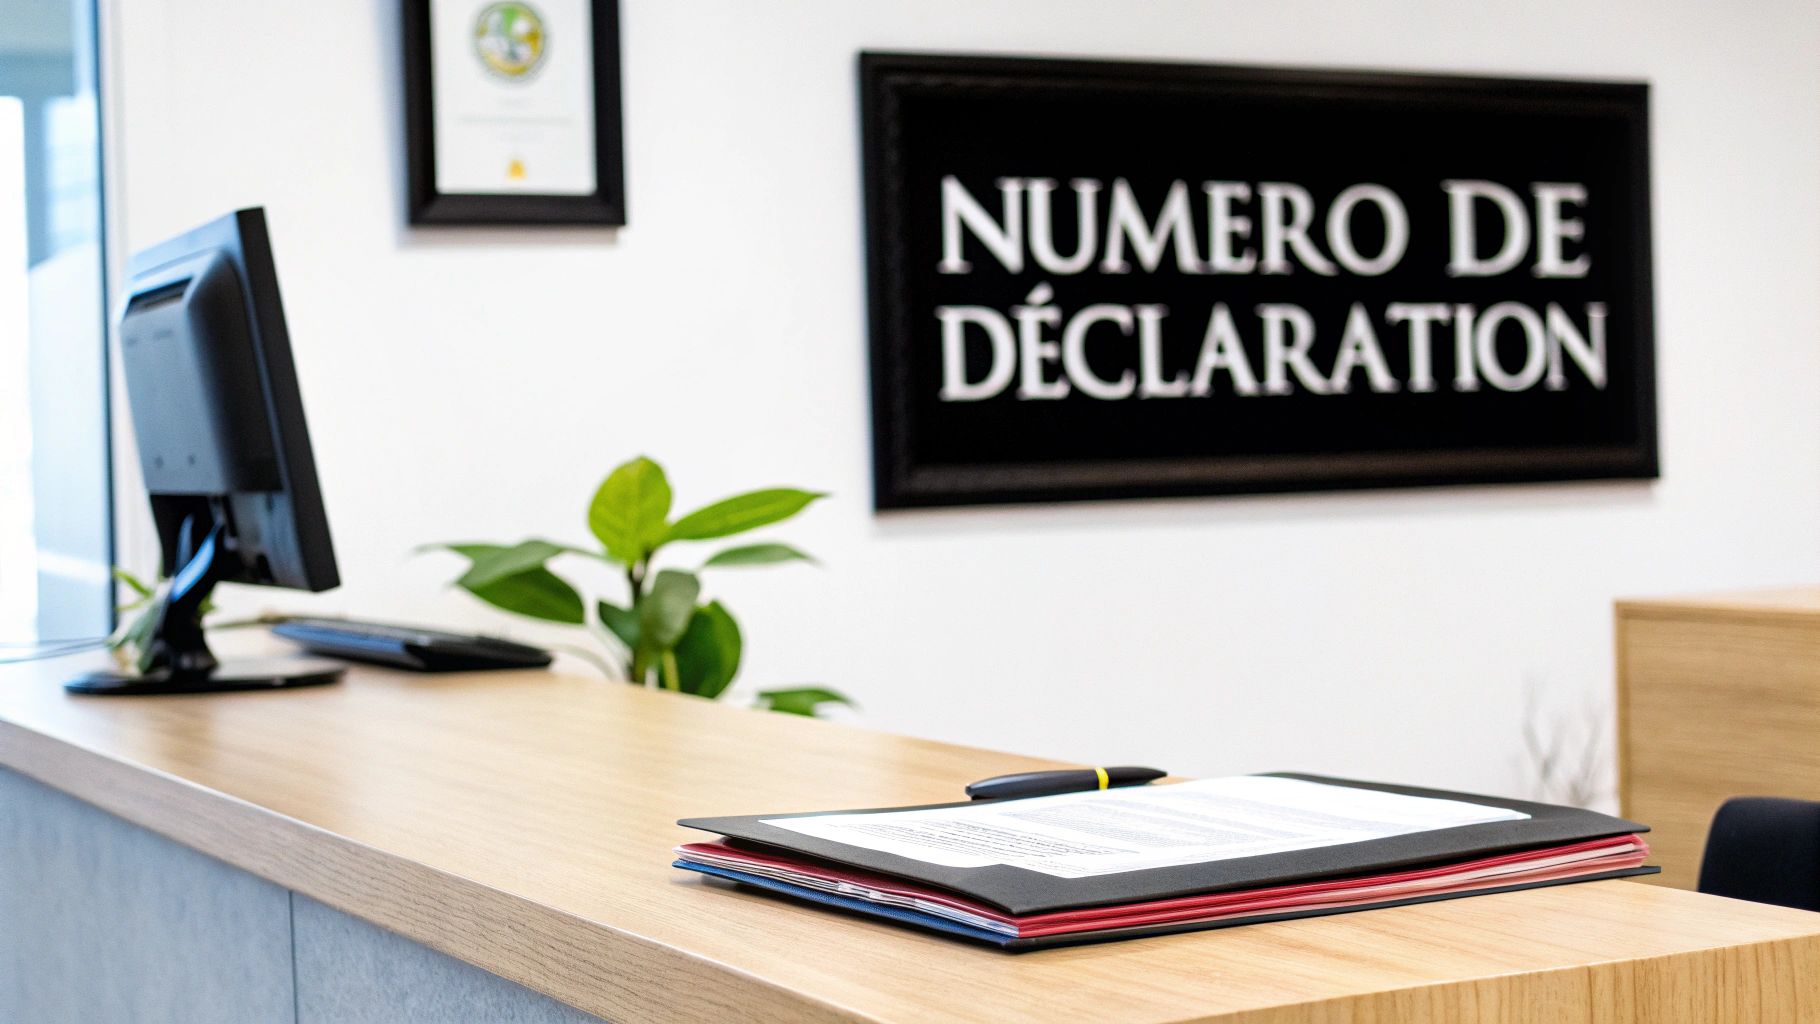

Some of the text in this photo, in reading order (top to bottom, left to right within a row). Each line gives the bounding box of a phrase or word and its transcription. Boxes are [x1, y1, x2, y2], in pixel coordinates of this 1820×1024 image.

[938, 175, 1591, 278] NUMERO DE
[937, 283, 1607, 401] DÉCLARATION
